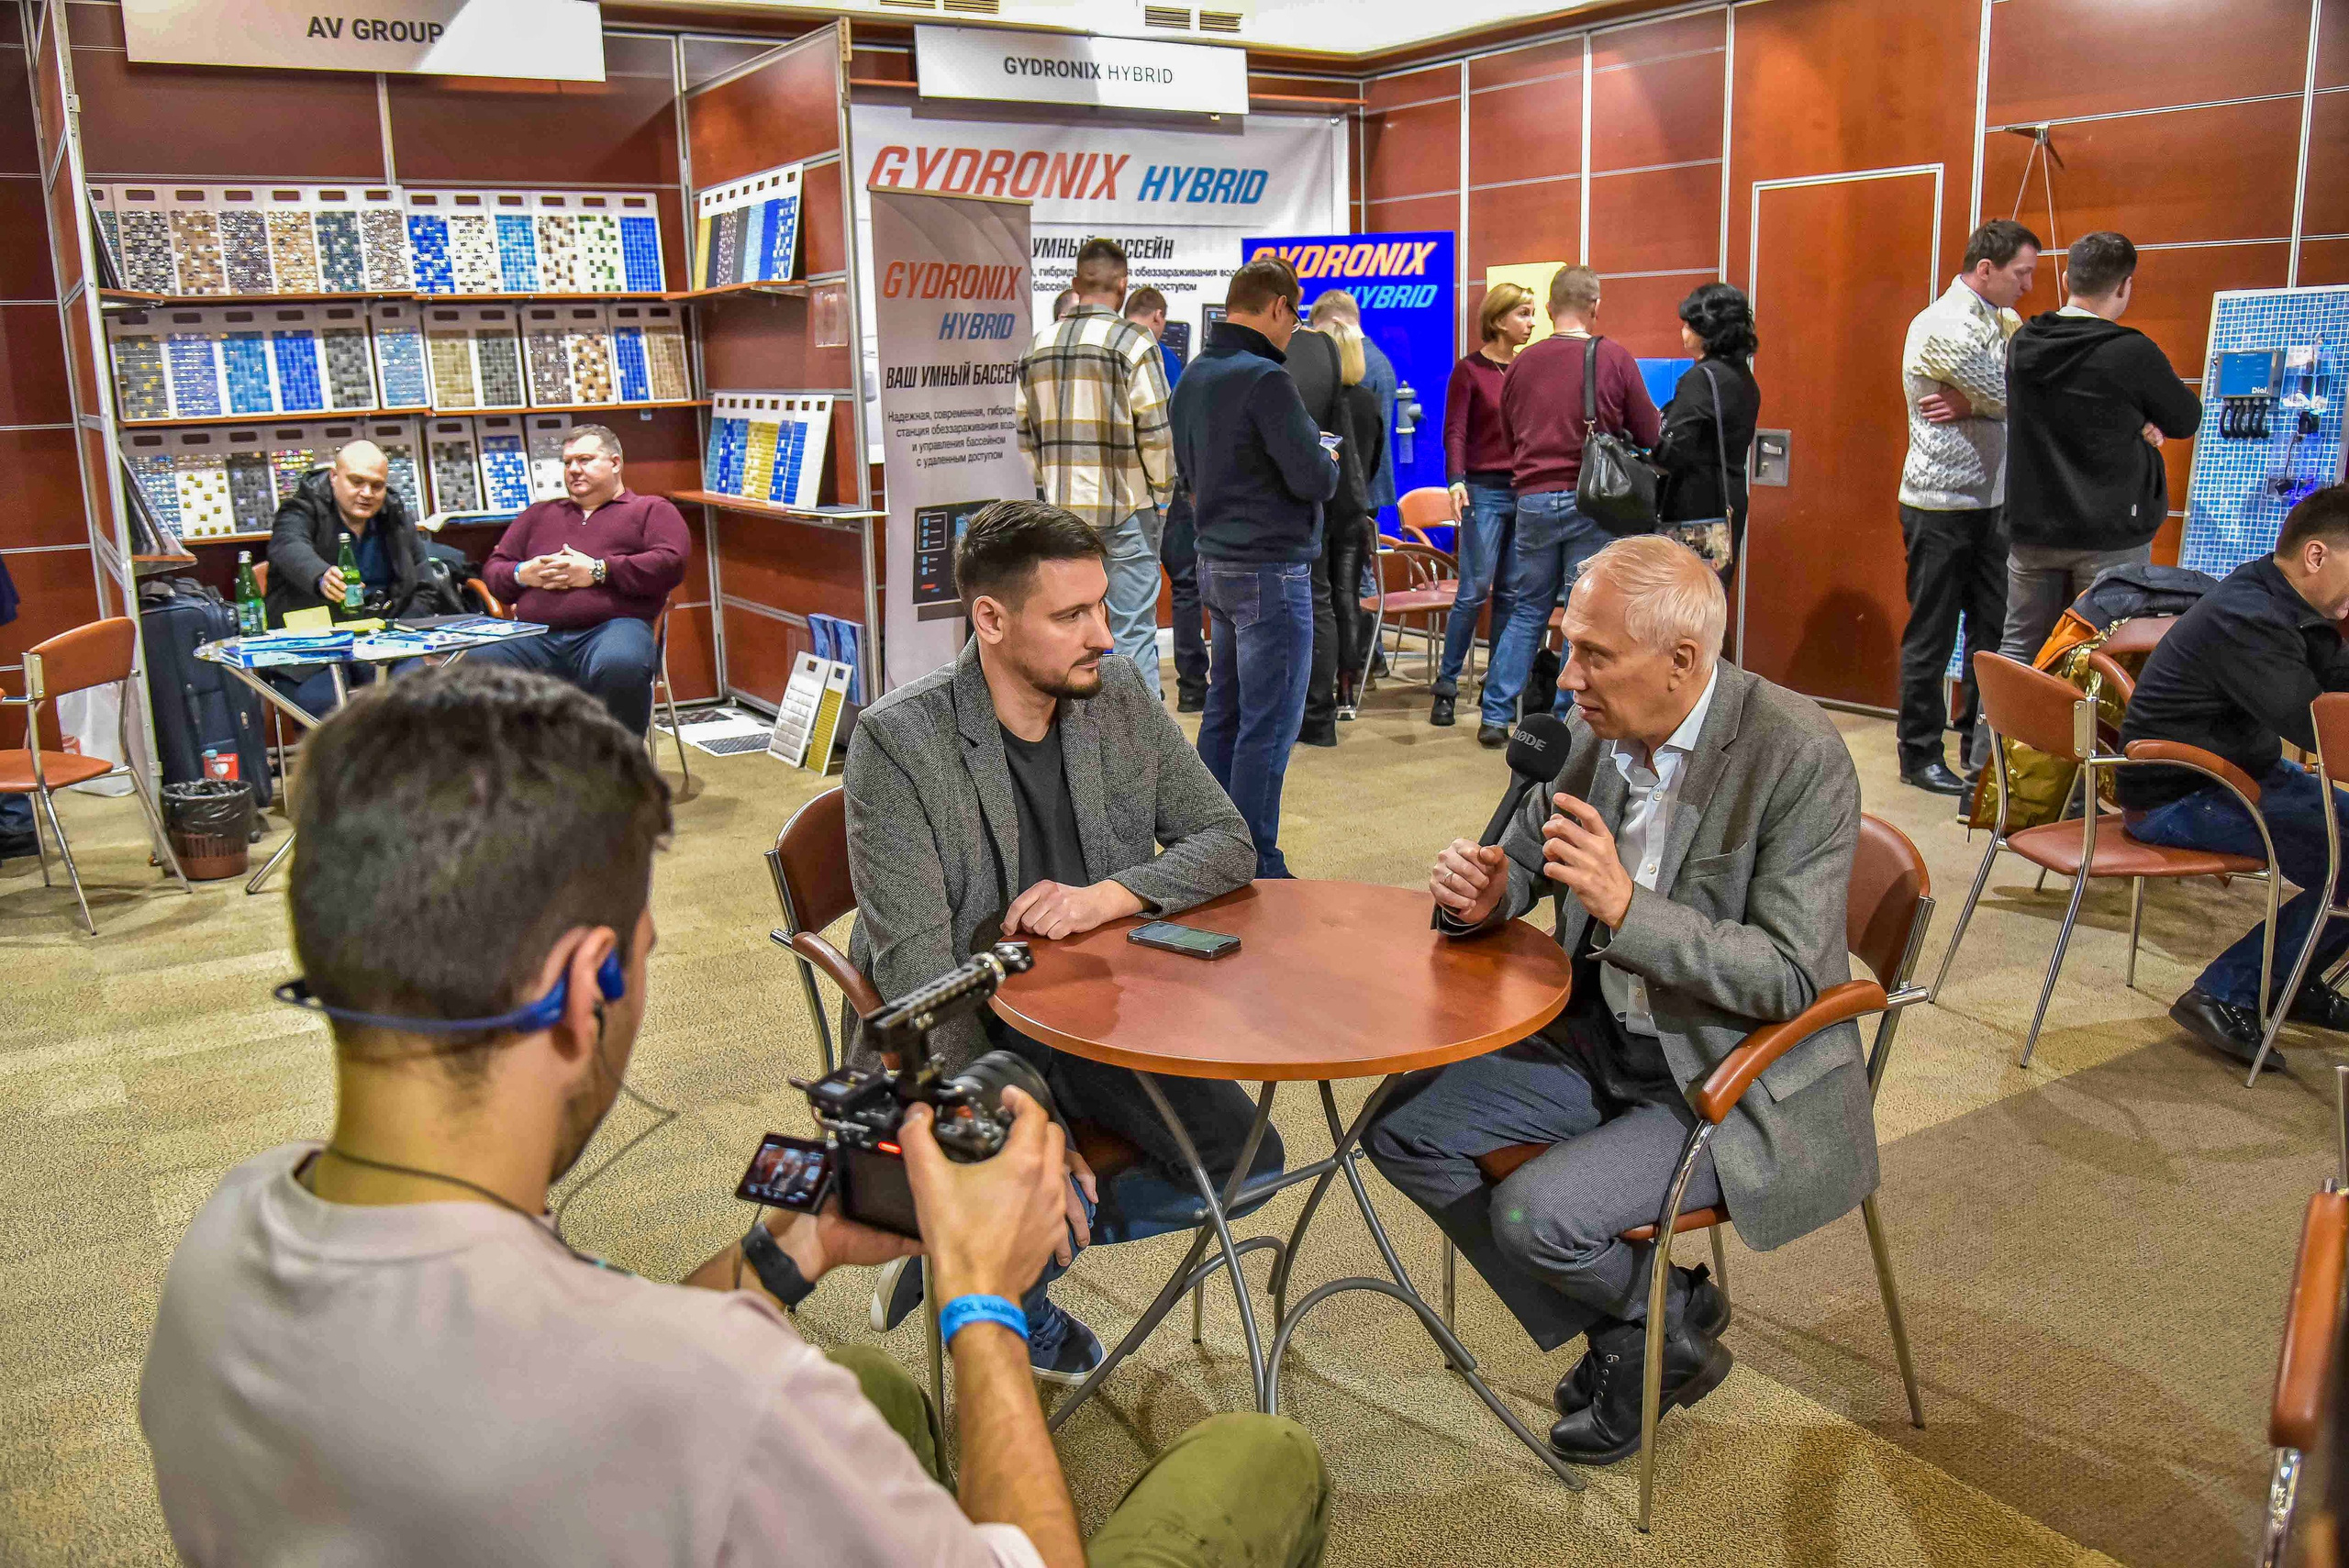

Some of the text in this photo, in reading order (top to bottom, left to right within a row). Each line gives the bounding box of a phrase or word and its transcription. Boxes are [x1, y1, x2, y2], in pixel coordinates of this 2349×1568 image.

[306, 16, 446, 44] AV GROUP
[1004, 57, 1174, 84] GYDRONIX HYBRID
[870, 146, 1269, 204] GYDRONIX HYBRID
[883, 261, 1023, 300] GYDRONIX
[939, 312, 1016, 340] HYBRID
[885, 361, 1019, 389] ВАШ УМНЫЙ БАССЕЙ
[896, 428, 930, 438] станция
[919, 439, 965, 454] управления
[967, 451, 1003, 463] доступом
